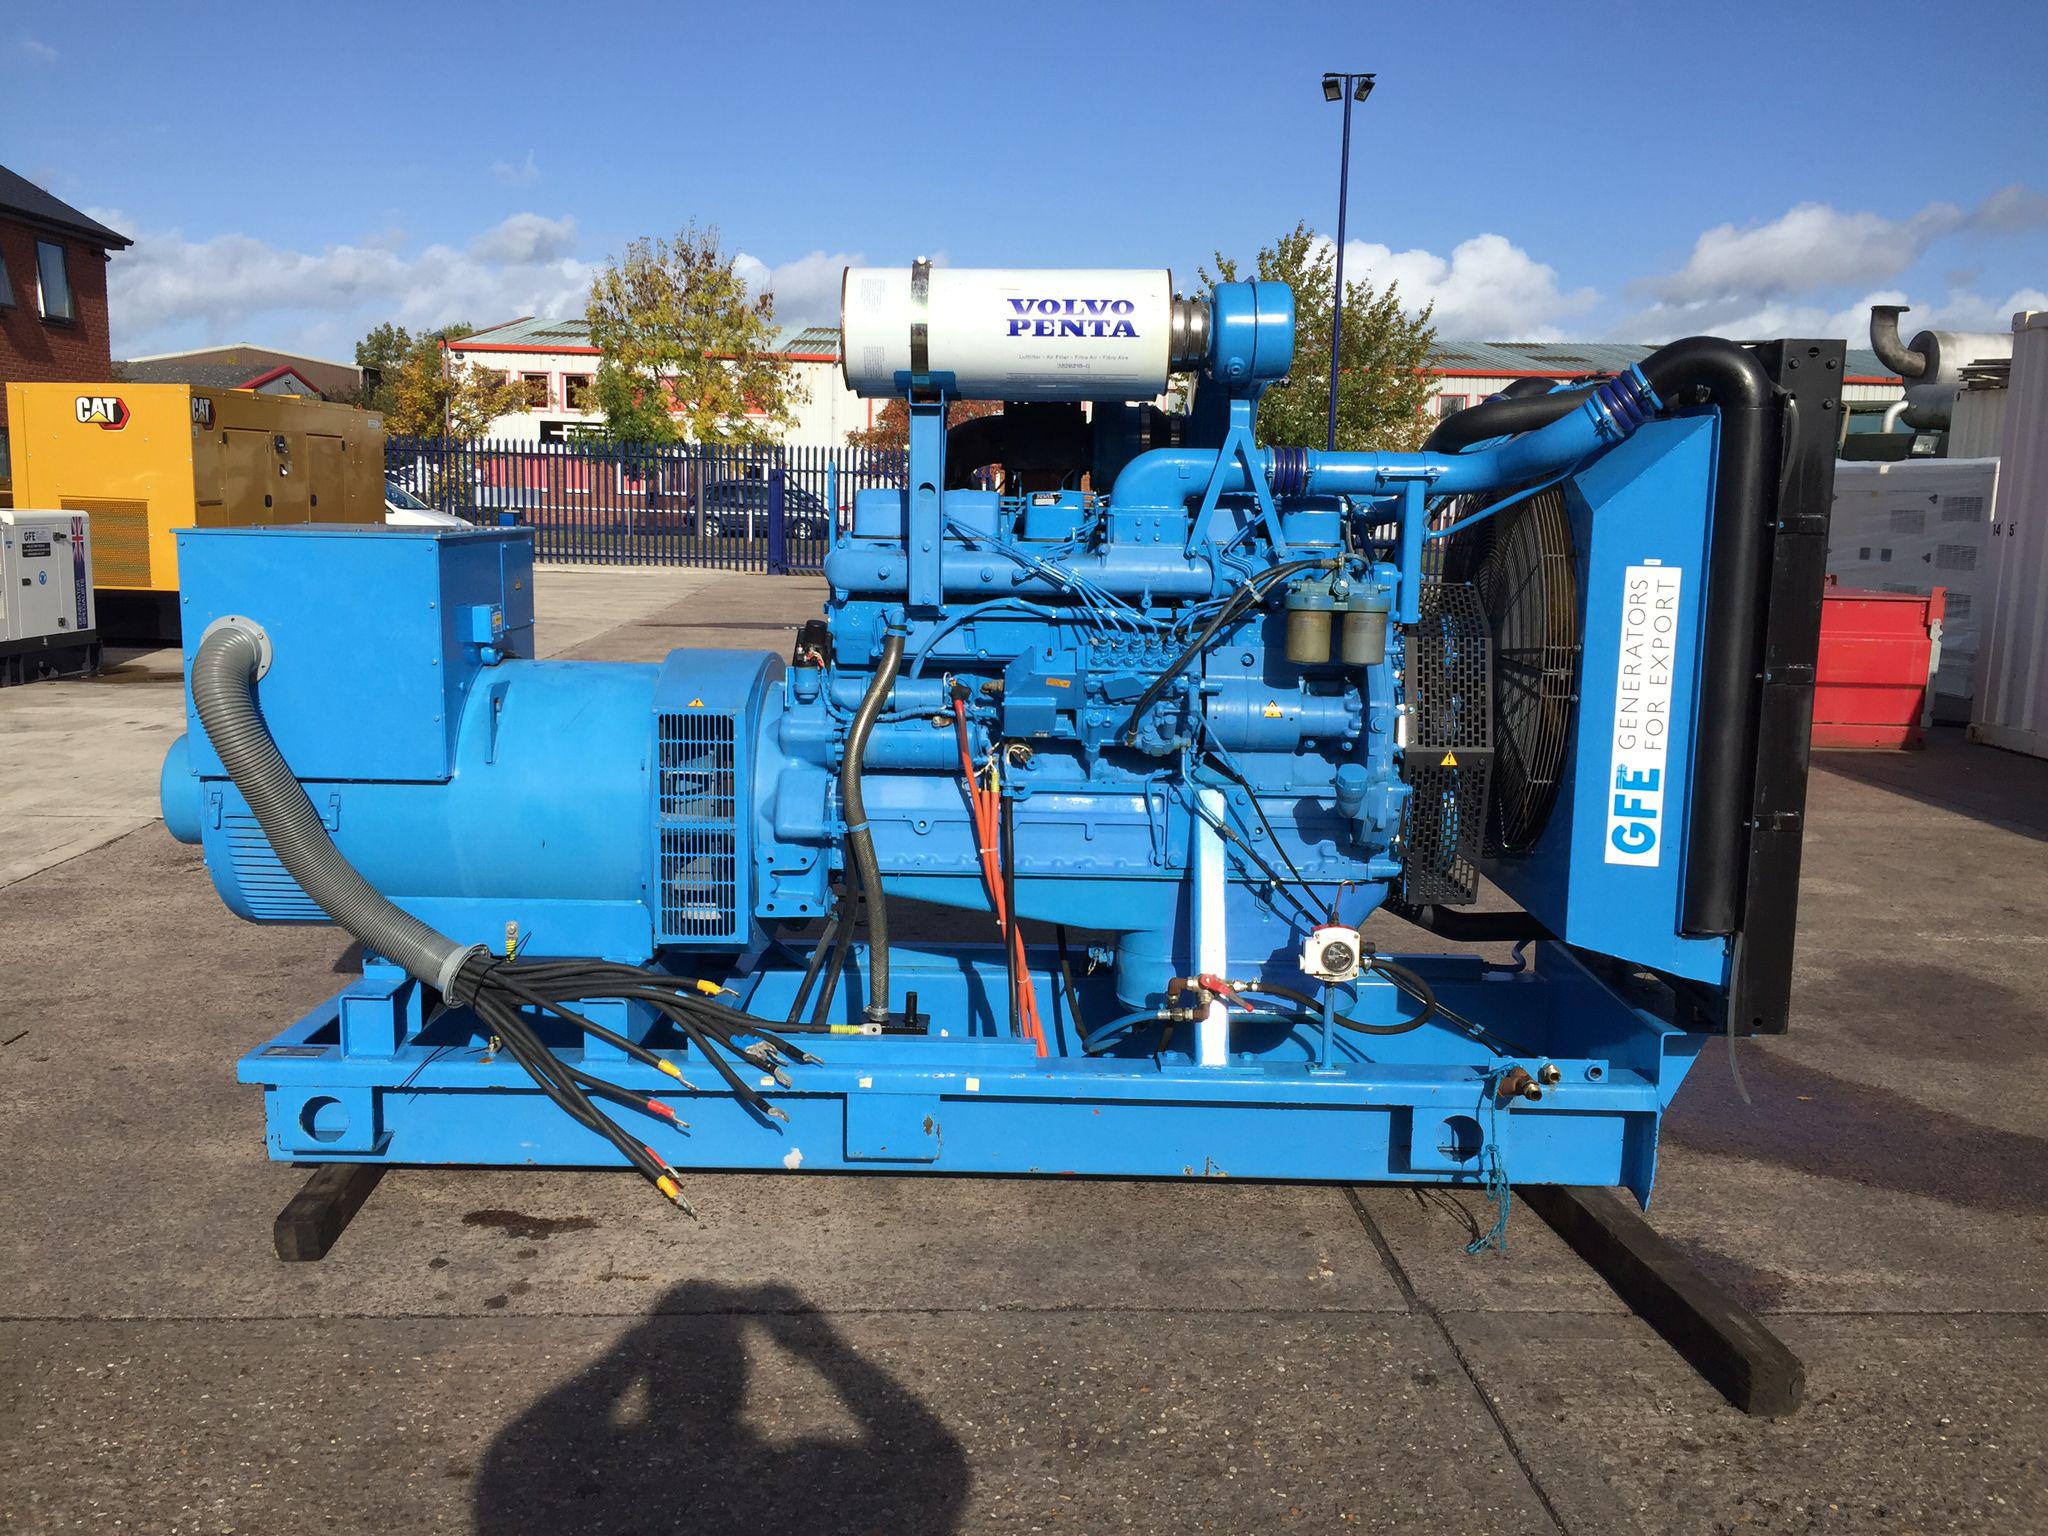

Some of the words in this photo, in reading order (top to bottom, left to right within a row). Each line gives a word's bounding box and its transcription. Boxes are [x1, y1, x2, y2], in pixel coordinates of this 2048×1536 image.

[1006, 298, 1135, 316] VOLVO
[1006, 319, 1141, 338] PENTA
[76, 397, 117, 422] CAT
[191, 397, 211, 423] CAT
[24, 531, 36, 542] GFE
[1649, 579, 1676, 685] EXPORT
[1617, 579, 1649, 750] GENERATORS
[1644, 700, 1666, 751] FOR
[1611, 766, 1660, 855] GFE
